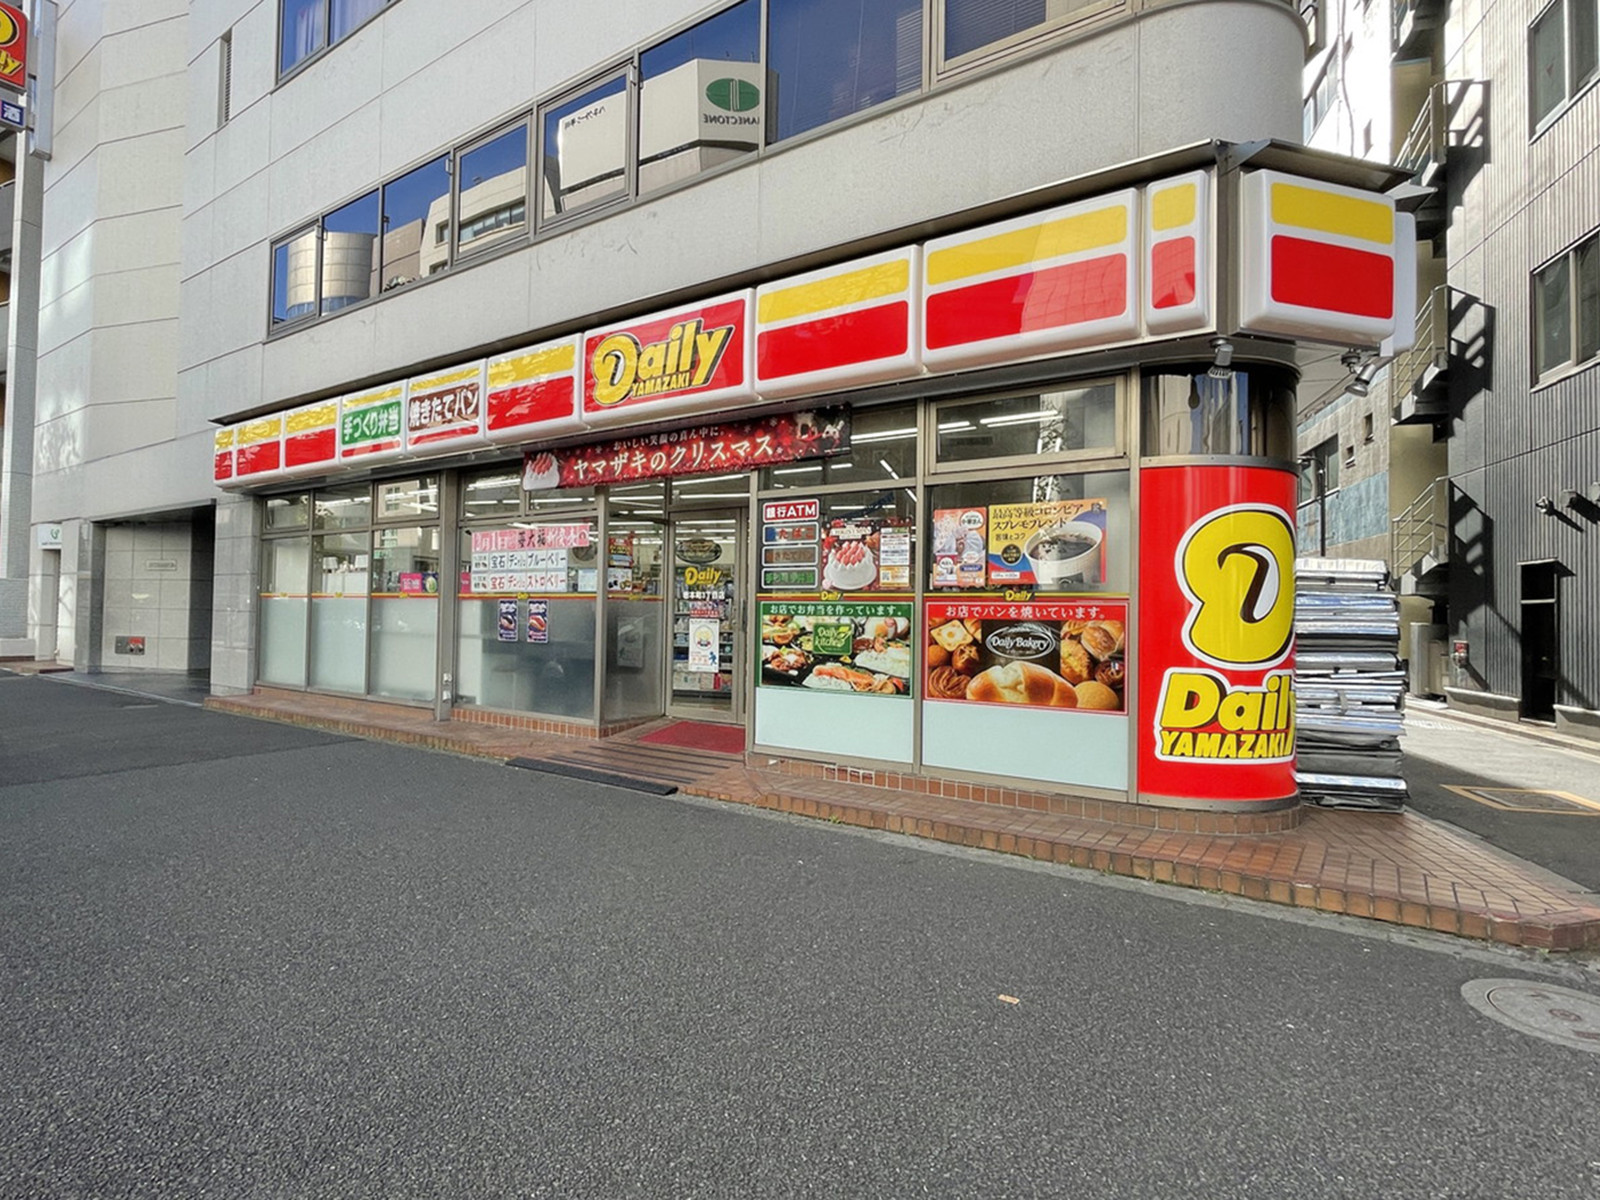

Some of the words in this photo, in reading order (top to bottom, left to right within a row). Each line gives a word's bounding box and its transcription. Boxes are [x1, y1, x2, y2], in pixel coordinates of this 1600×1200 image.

[593, 320, 735, 404] Daily
[632, 372, 691, 397] YAMAZAKI
[409, 389, 479, 427] 焼きたてパン
[343, 404, 399, 441] 手づくり弁当
[573, 434, 774, 481] ヤマザキのクリスマス
[766, 501, 816, 518] 銀行ATM
[992, 516, 1068, 532] スプレモブレンド
[777, 527, 814, 540] たばこ
[685, 567, 722, 586] Daily
[1004, 590, 1032, 601] Daily
[770, 605, 902, 616] お店でお弁当を作っています。
[945, 605, 1106, 619] お店でパンを焼いています。
[817, 627, 838, 639] Daily
[991, 636, 1016, 649] Daily
[1015, 636, 1049, 650] Bakery
[1160, 730, 1286, 759] YAMAZAKI
